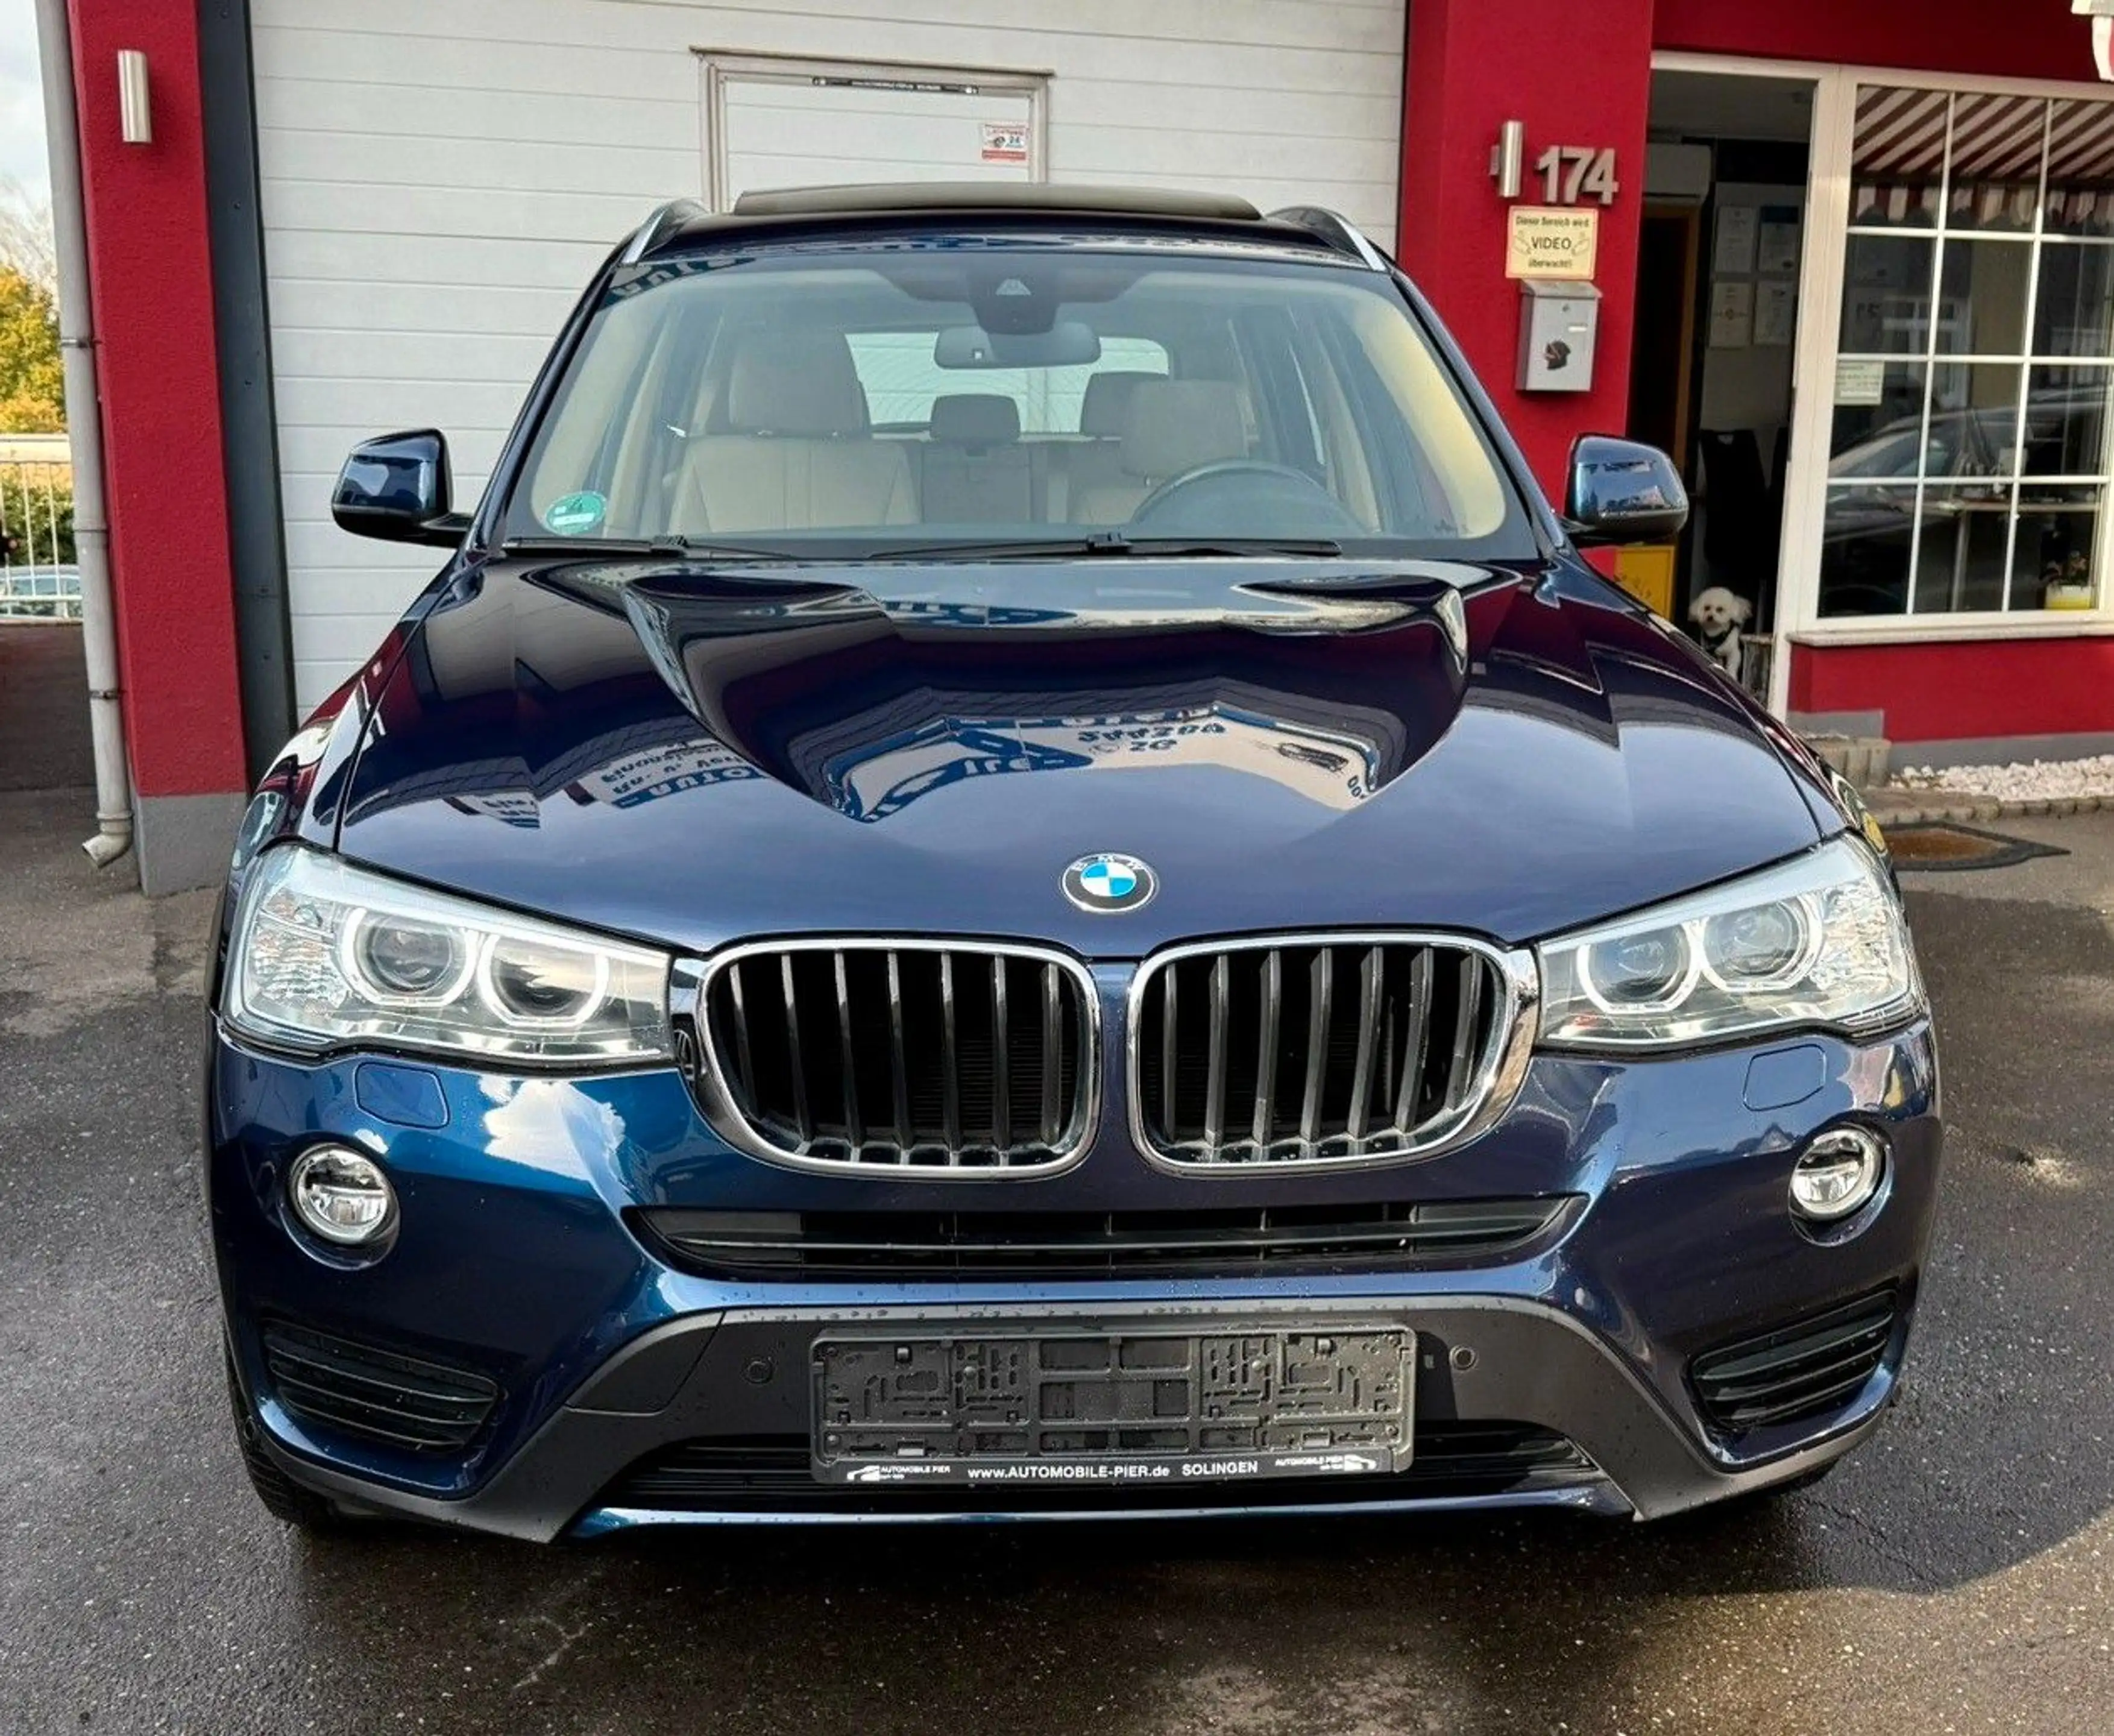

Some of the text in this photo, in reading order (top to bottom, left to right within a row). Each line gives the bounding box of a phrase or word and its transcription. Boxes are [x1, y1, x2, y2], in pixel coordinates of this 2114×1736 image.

[1535, 145, 1619, 205] 174
[1531, 237, 1572, 250] VIDEO
[967, 1461, 1259, 1479] www.AUTOMOBILE-PIER.de SOLINGEN
